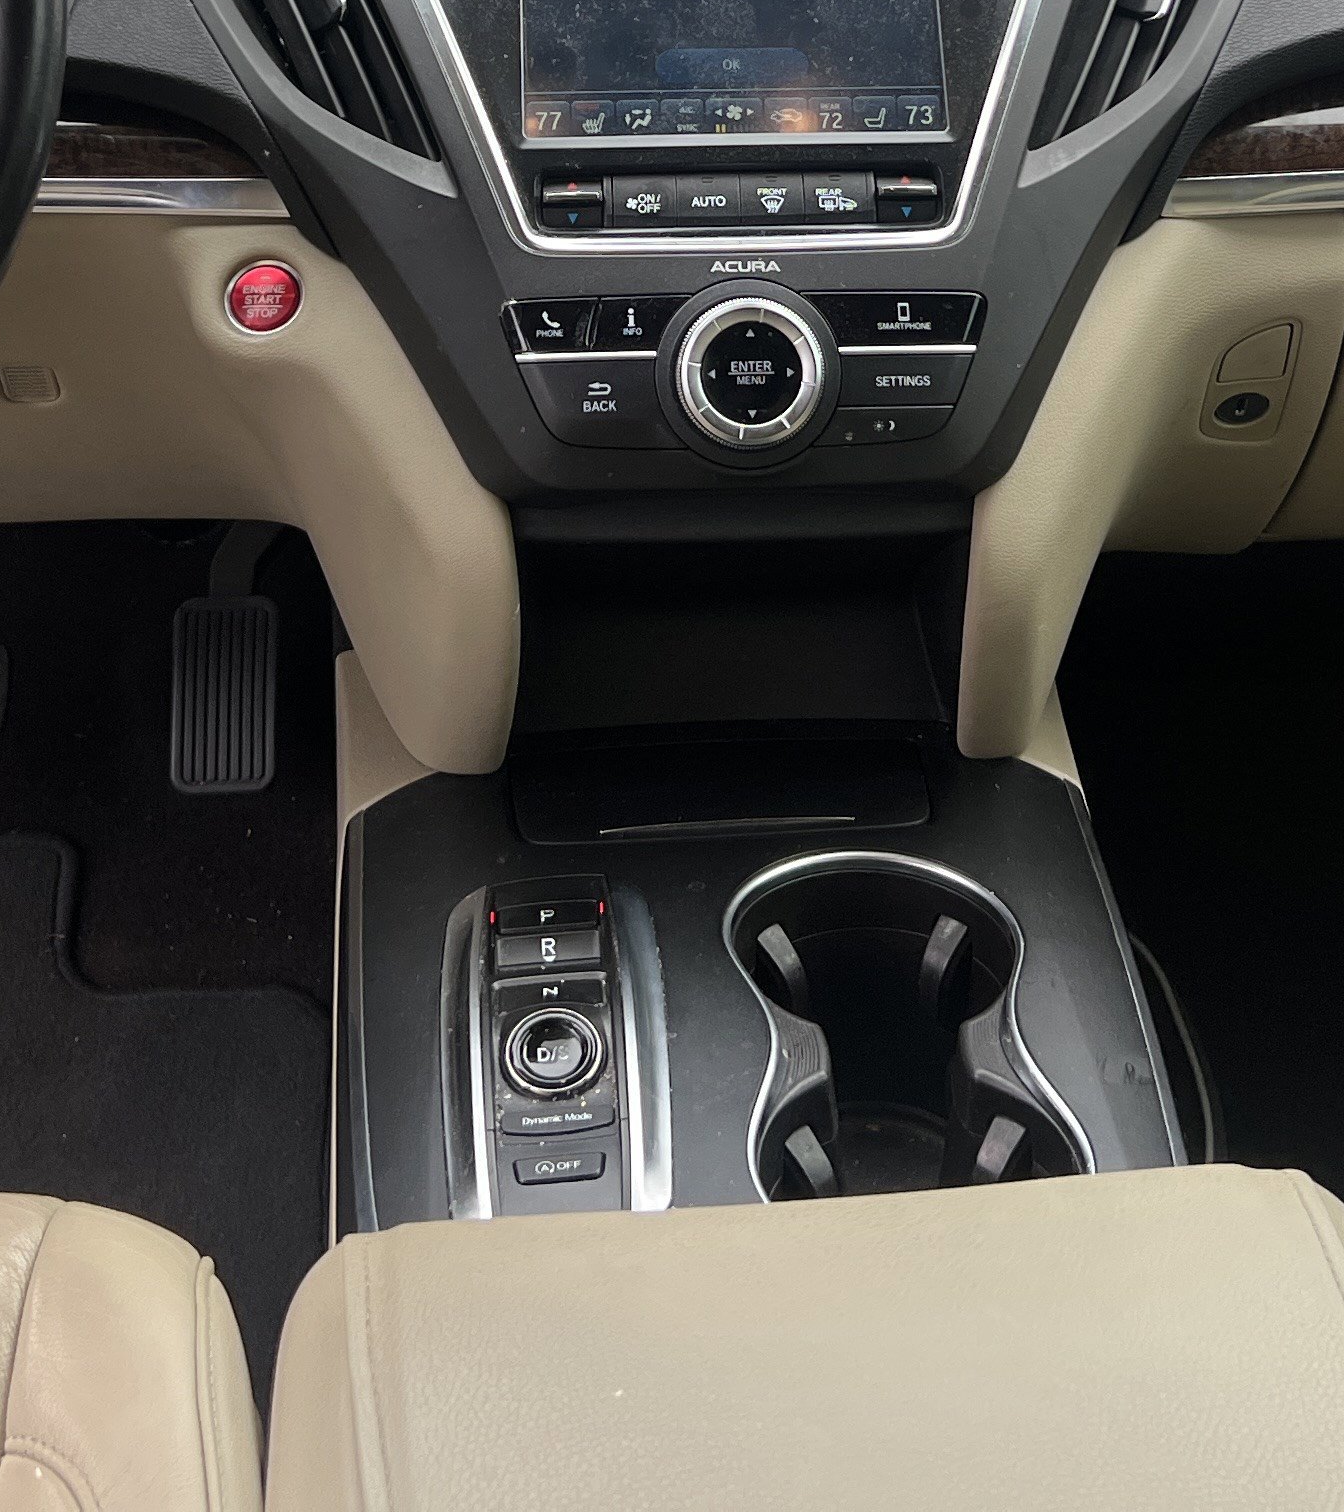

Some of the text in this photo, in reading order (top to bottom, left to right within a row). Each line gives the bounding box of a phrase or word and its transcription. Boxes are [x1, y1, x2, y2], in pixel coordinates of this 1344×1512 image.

[722, 58, 741, 72] OK
[535, 111, 563, 131] 77
[819, 112, 844, 130] 72
[757, 188, 787, 196] FRONT
[815, 188, 843, 196] REAR
[691, 196, 727, 208] AUTO
[637, 203, 662, 214] OFF
[710, 259, 781, 273] ACURA
[242, 284, 286, 295] ENGINE
[244, 294, 282, 305] START
[246, 308, 278, 319] STOP
[622, 326, 643, 337] INFO
[876, 320, 932, 332] SMARTPHONE
[535, 327, 564, 338] PHONE
[730, 359, 773, 373] ENTER
[736, 374, 767, 386] MENU
[874, 374, 932, 388] SETTINGS
[582, 399, 617, 413] BACK
[539, 909, 555, 923] P
[540, 937, 557, 957] R
[542, 986, 559, 997] N
[521, 1112, 593, 1127] Dynamic Mode
[557, 1160, 582, 1171] OFF
